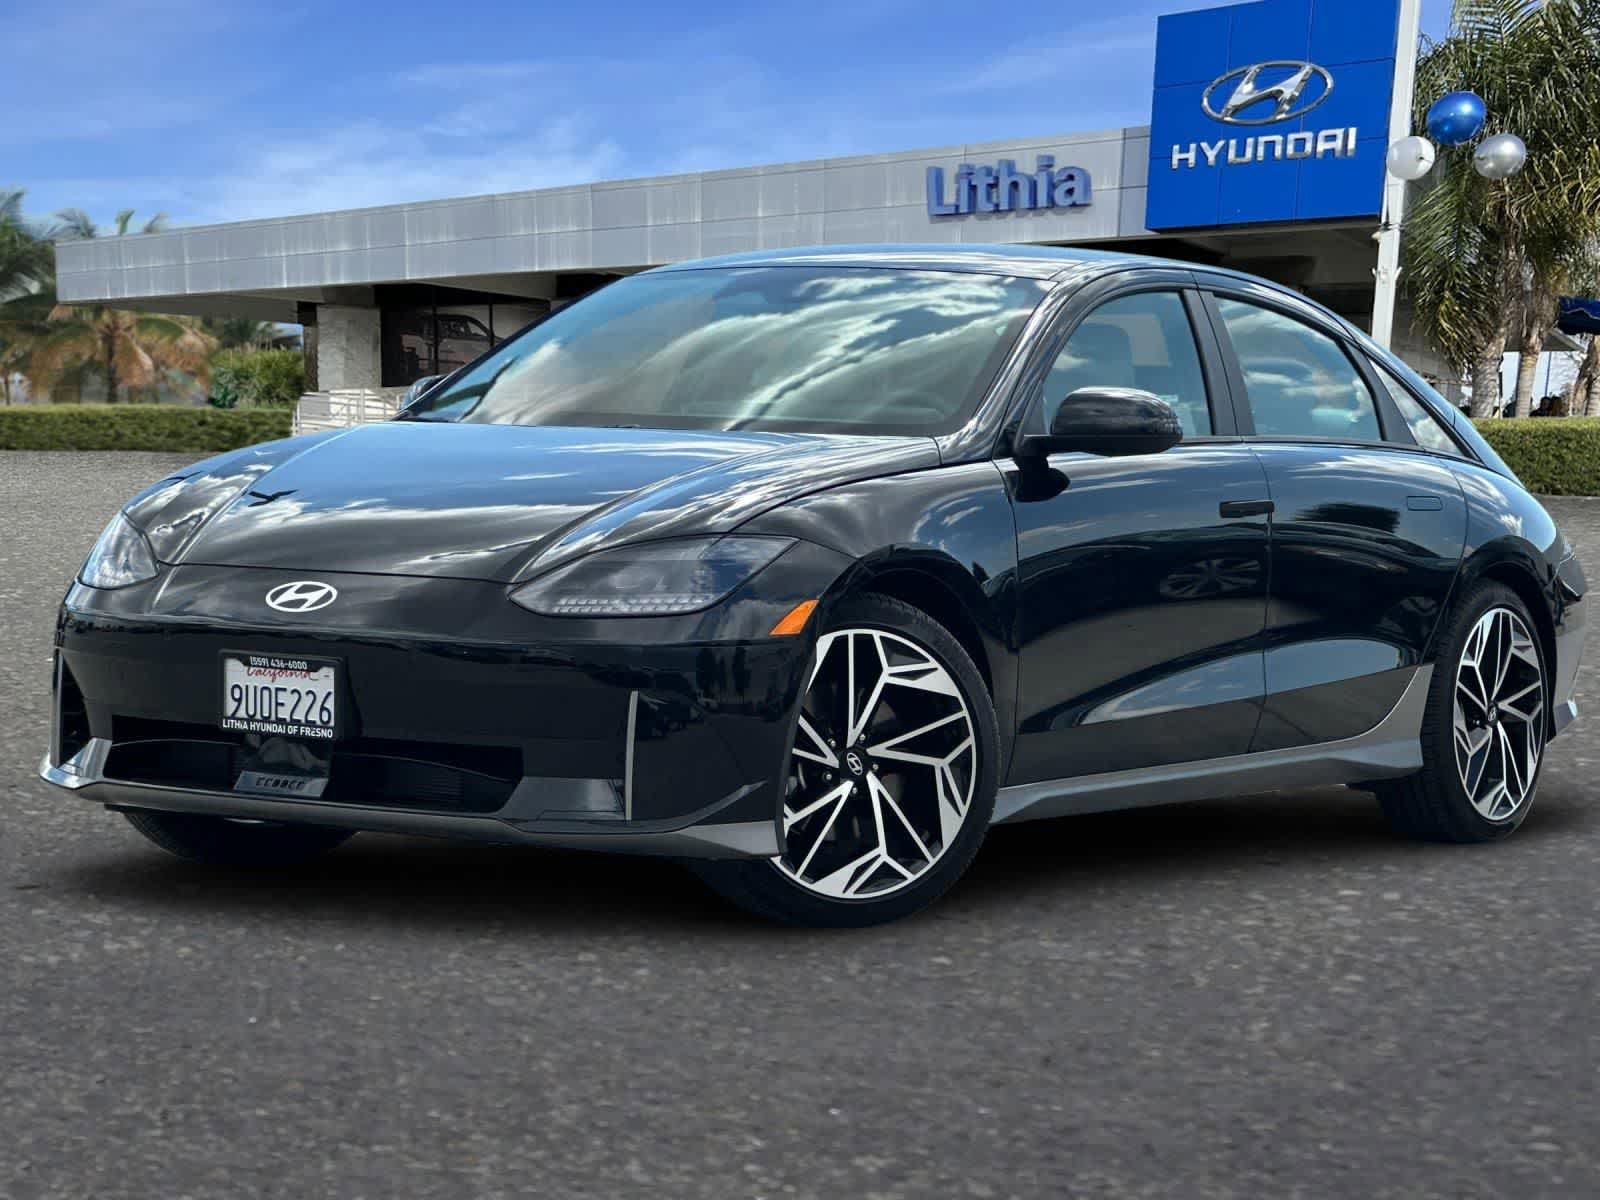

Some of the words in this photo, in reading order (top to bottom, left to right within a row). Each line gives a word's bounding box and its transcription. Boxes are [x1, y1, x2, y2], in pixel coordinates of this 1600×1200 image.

[1171, 127, 1357, 169] HYUNDAI
[926, 154, 1092, 217] Lithia
[250, 656, 269, 667] (559)
[270, 659, 308, 670] 436-6000
[222, 719, 249, 731] LITHIA
[249, 721, 286, 734] HYUNDAI
[287, 726, 299, 735] OF
[300, 726, 334, 739] FRESNO
